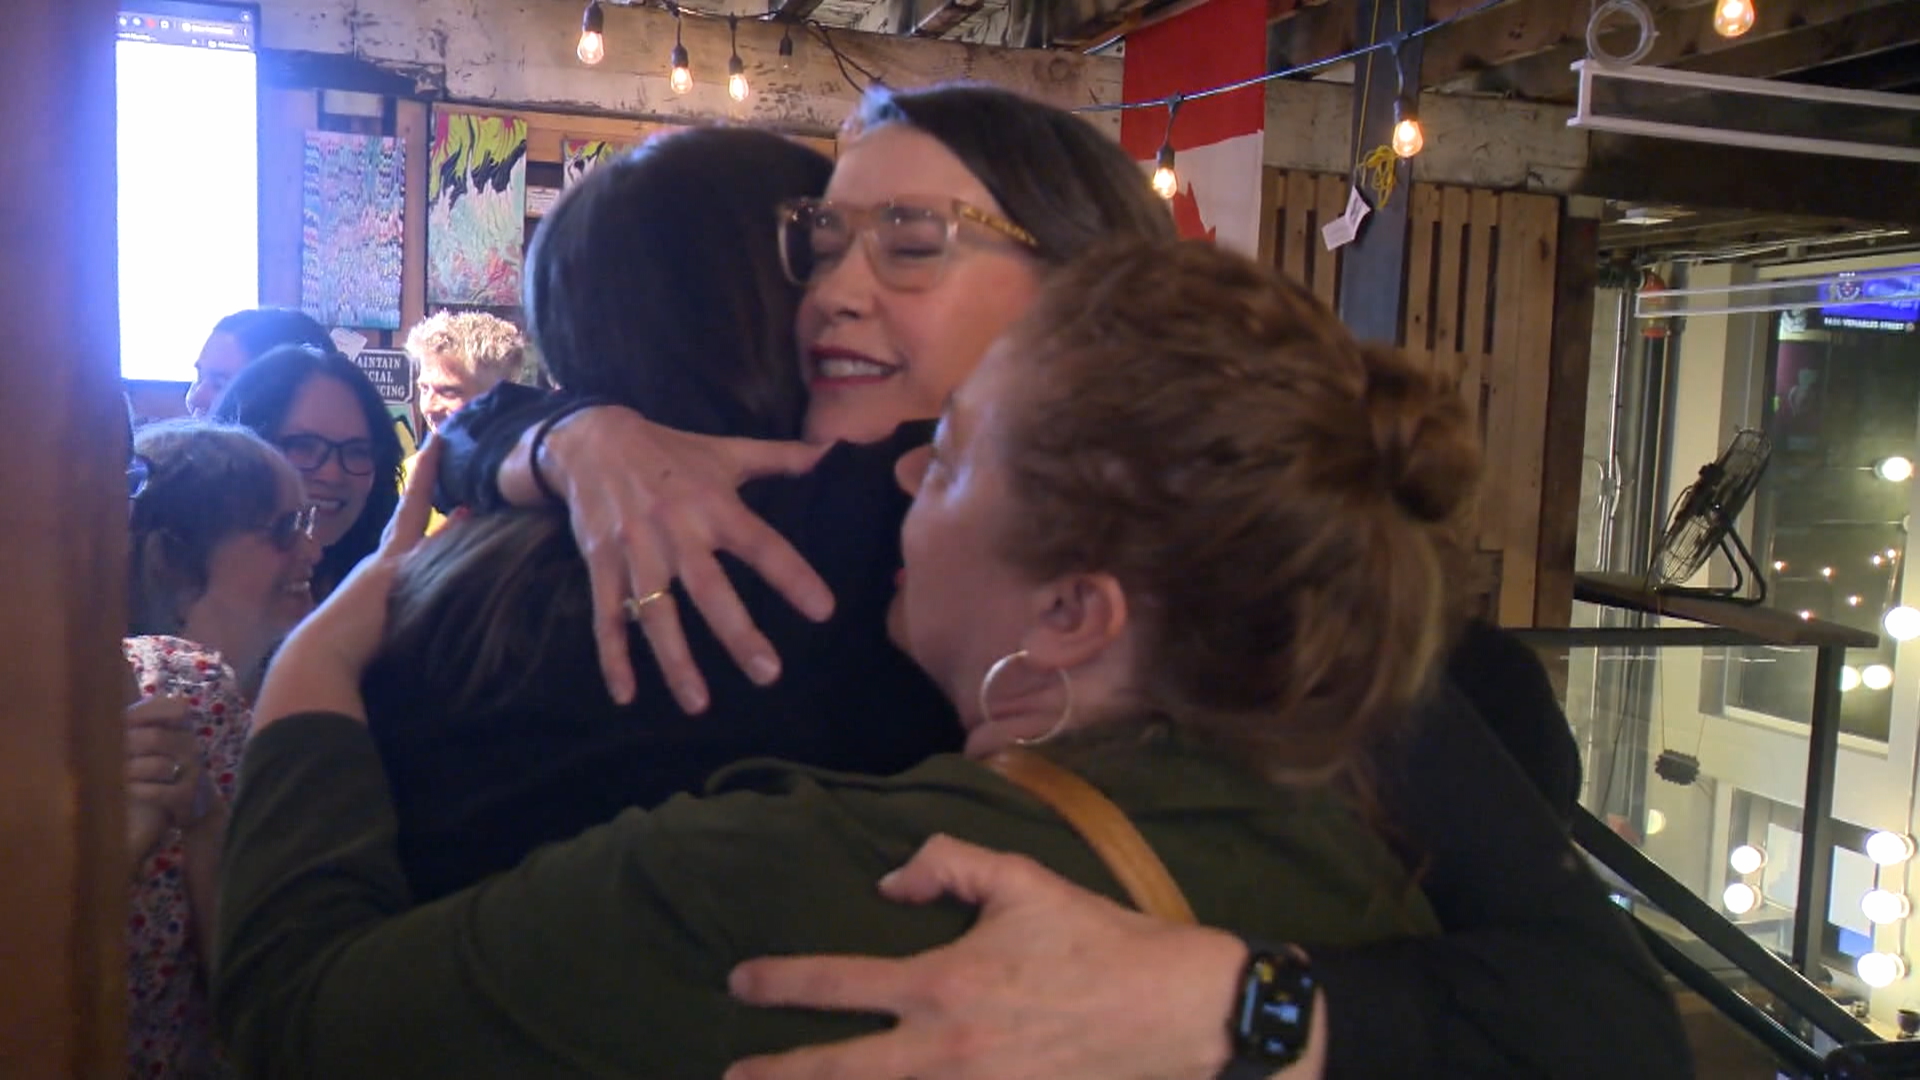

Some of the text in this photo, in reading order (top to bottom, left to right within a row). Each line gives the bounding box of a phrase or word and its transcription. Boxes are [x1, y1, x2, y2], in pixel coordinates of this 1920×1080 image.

[355, 356, 401, 369] AINTAIN
[364, 370, 394, 384] CIAL
[377, 384, 405, 398] CING
